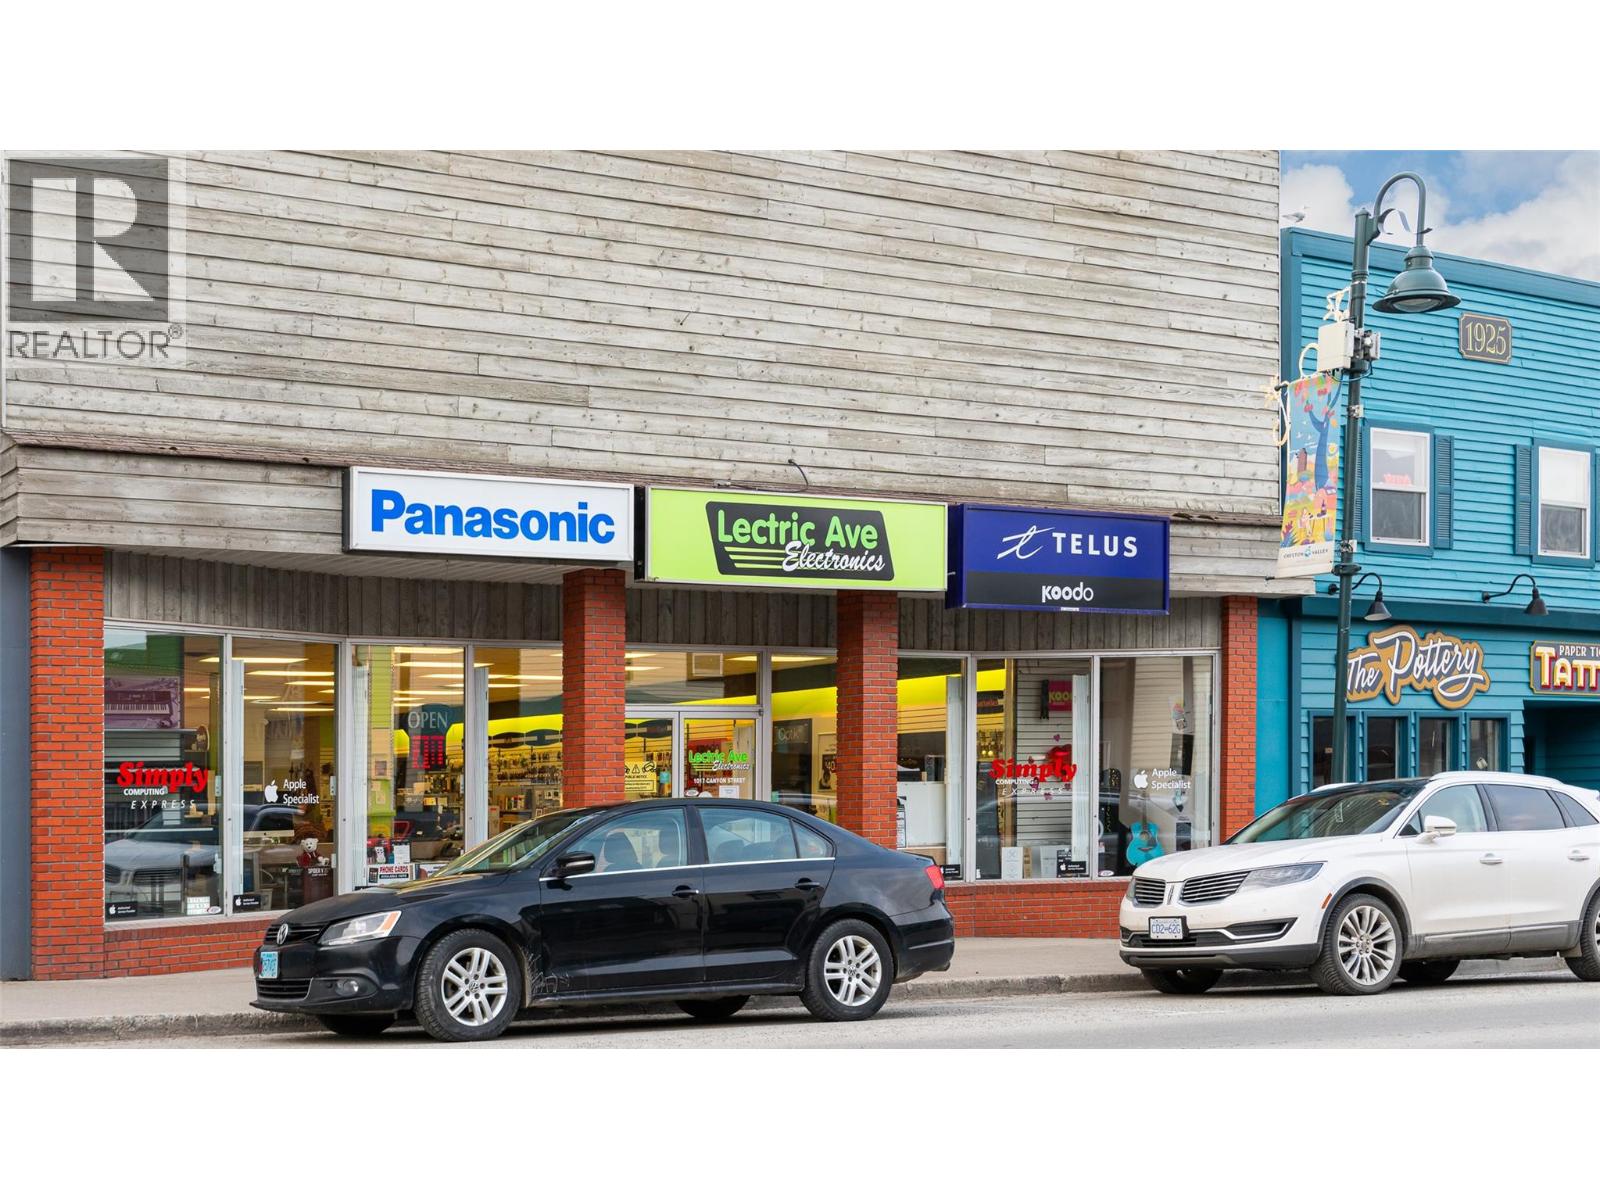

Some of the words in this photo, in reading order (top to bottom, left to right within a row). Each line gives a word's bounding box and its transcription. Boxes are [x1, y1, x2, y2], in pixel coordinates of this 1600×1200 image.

[1465, 321, 1507, 355] 1925
[371, 488, 615, 544] Panasonic
[717, 509, 816, 548] Lectric
[825, 515, 878, 549] Ave
[1052, 532, 1138, 558] TELUS
[781, 540, 886, 572] Electronics
[1559, 645, 1587, 657] PAPER
[1589, 646, 1600, 658] TI
[1347, 652, 1379, 692] The
[1373, 630, 1485, 697] Pottery
[407, 711, 448, 729] OPEN
[688, 749, 725, 763] Lectric
[727, 749, 748, 763] Ave
[116, 761, 209, 794] Simply
[988, 757, 1078, 783] Simply
[1151, 767, 1178, 779] Apple
[123, 787, 166, 796] COMPUTING
[282, 777, 307, 791] Apple
[1151, 779, 1192, 791] Specialist
[130, 799, 195, 810] EXPRESS
[282, 793, 320, 806] Specialist
